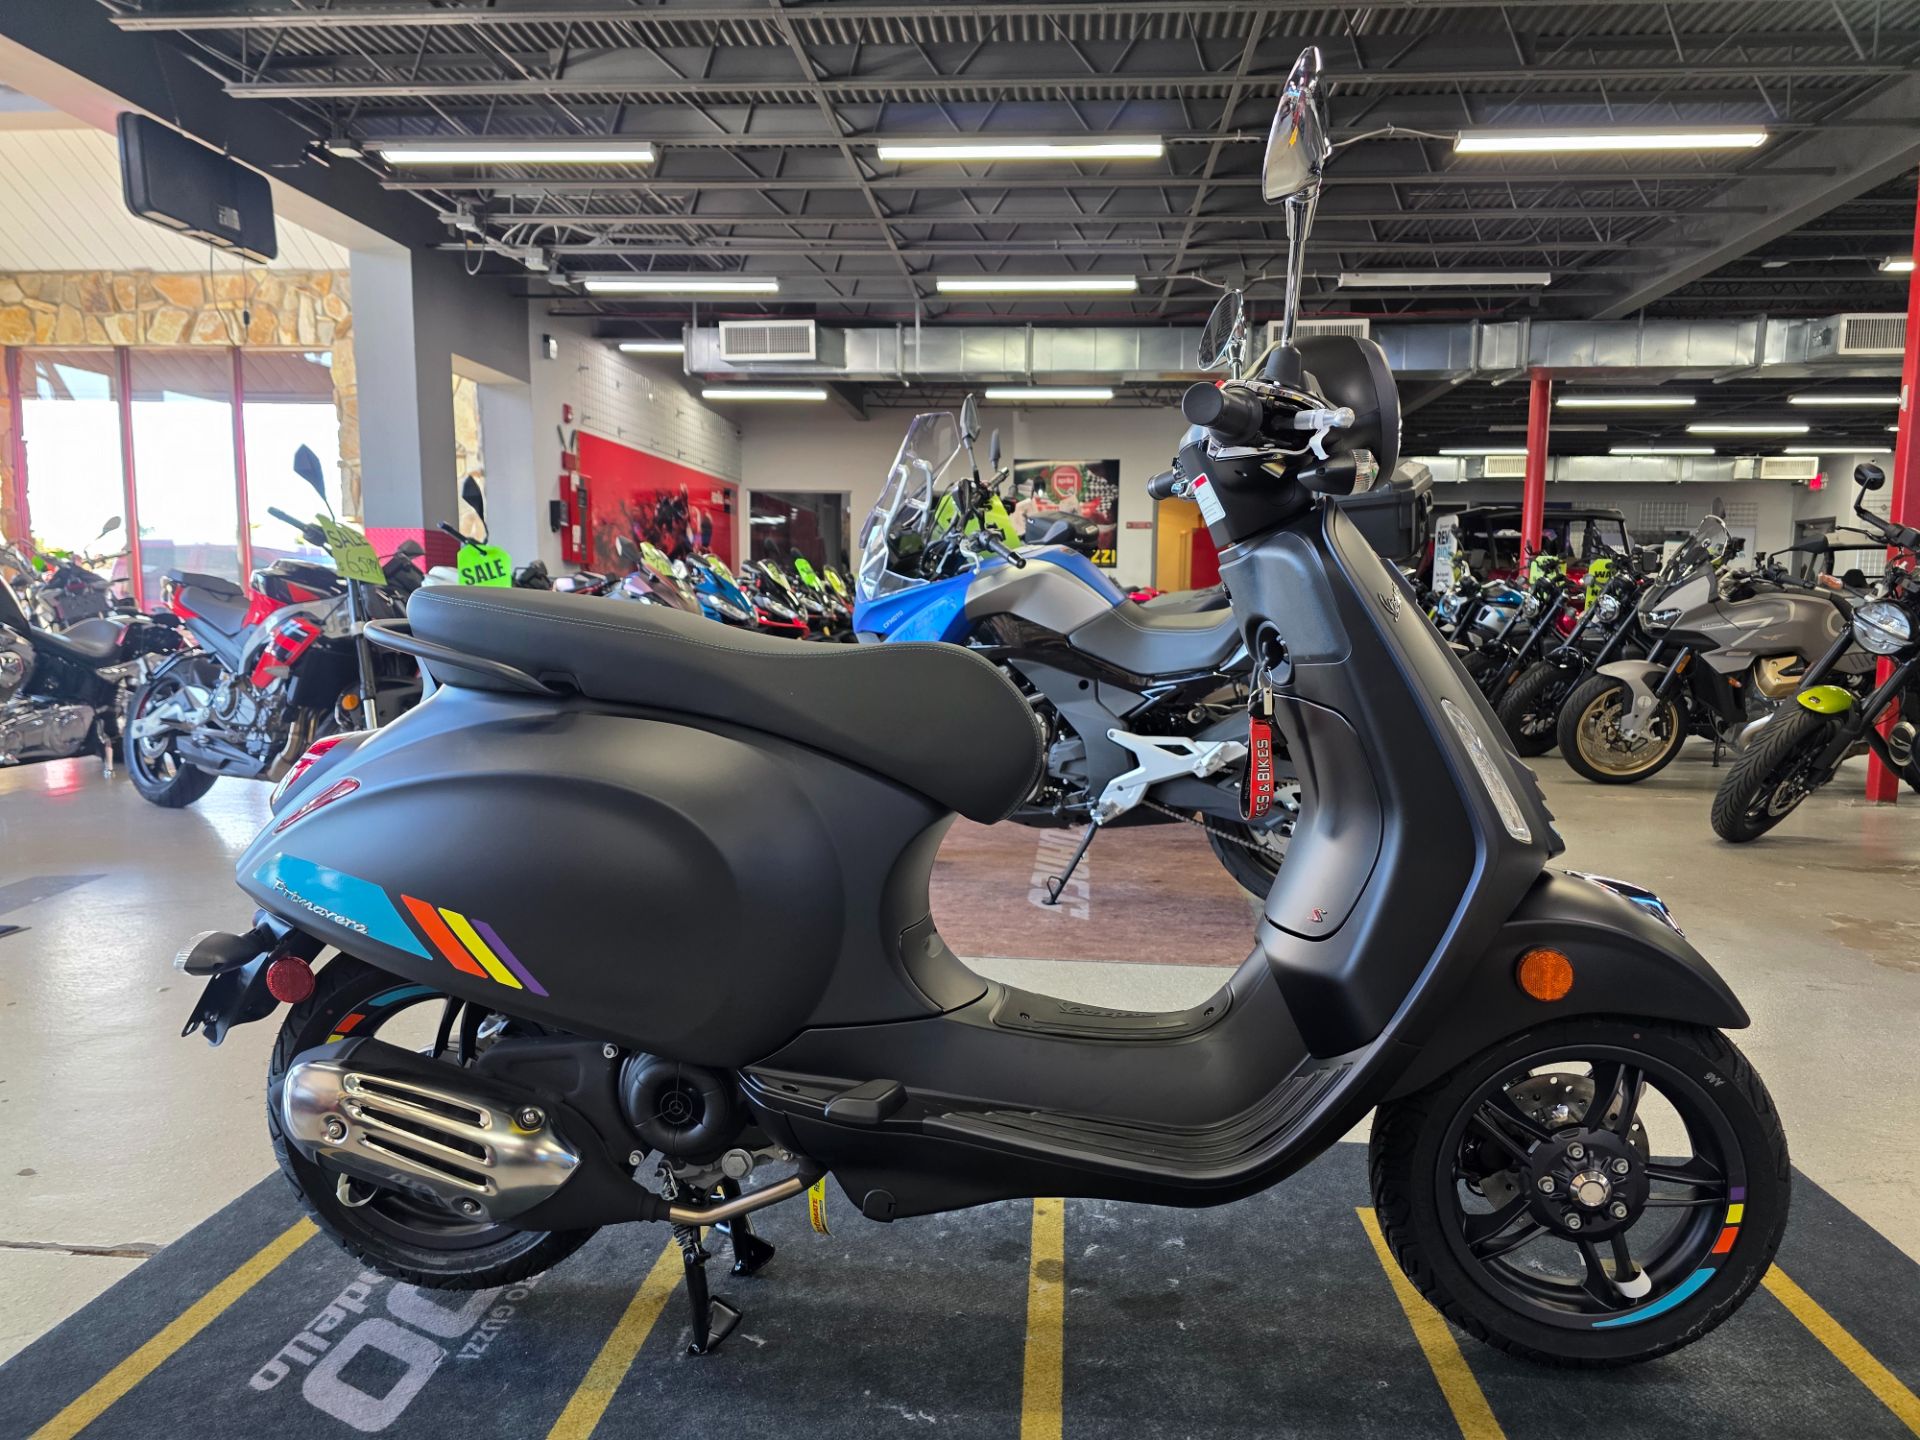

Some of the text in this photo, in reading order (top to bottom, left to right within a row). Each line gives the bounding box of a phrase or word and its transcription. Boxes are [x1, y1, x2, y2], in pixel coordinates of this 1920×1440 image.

[327, 529, 369, 548] SALE
[1090, 549, 1117, 564] ZZI
[461, 559, 507, 586] SALE
[1256, 739, 1270, 782] BIKES
[1258, 784, 1270, 792] &
[273, 877, 369, 935] Primavera
[455, 1305, 516, 1360] GUZZI
